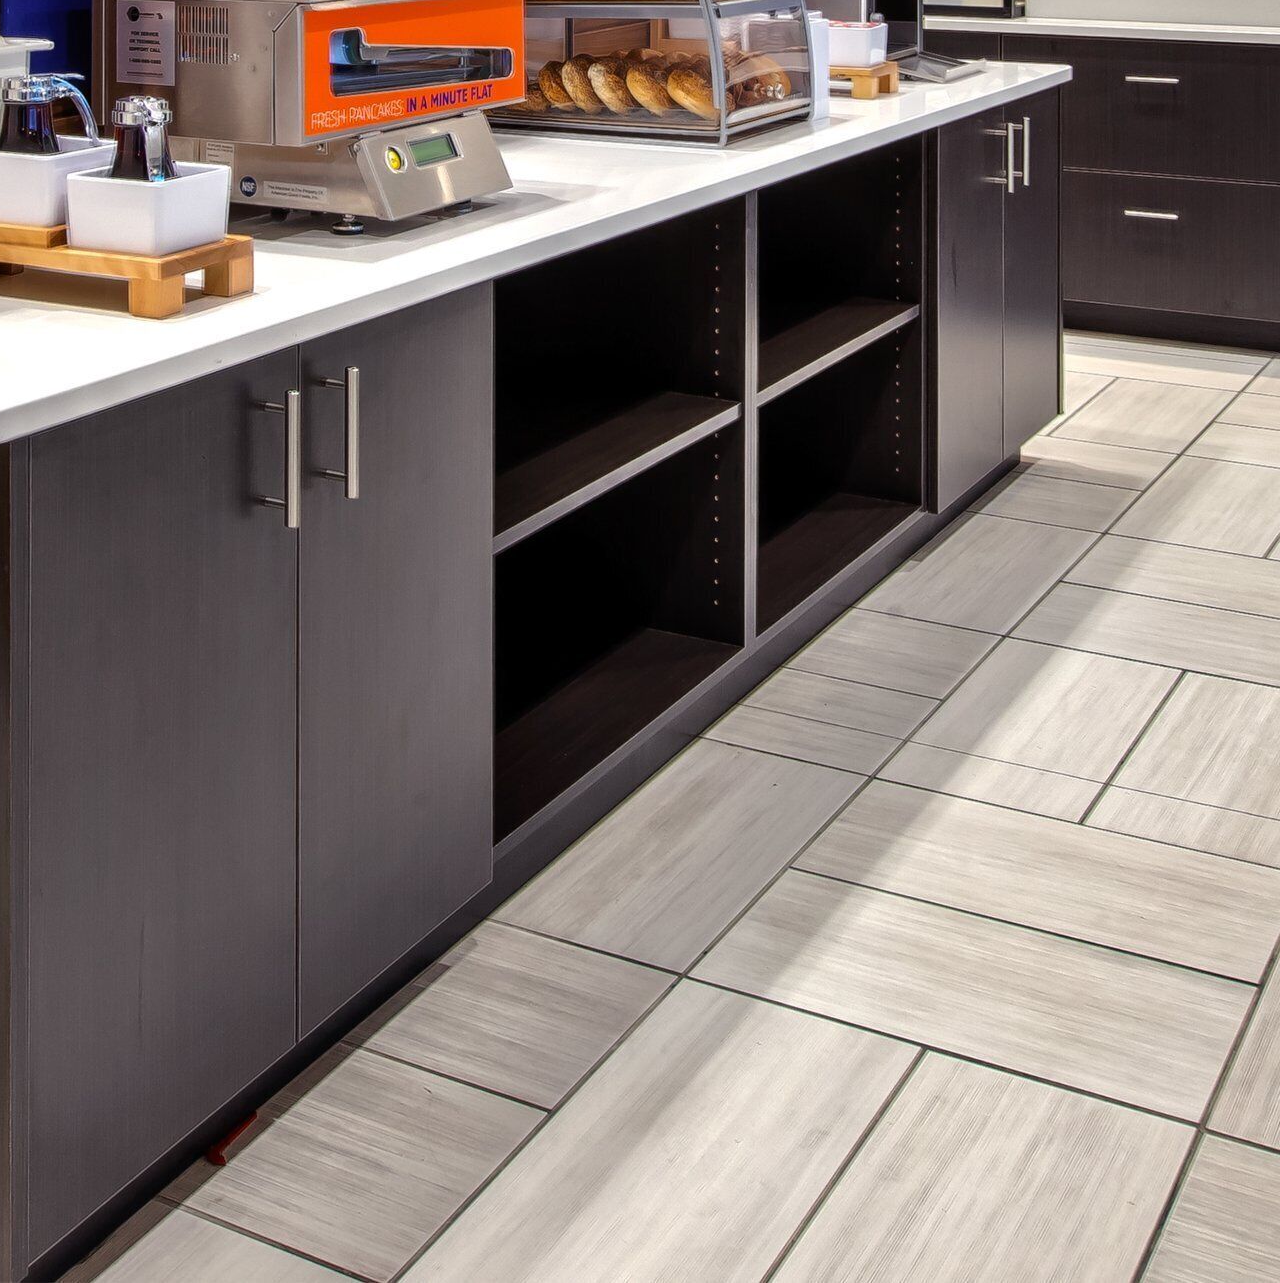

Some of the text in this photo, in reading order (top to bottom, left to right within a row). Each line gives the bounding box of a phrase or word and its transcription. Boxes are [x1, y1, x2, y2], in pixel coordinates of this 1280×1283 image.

[311, 84, 492, 130] FRESH PANCAKES IN A MINUTE FLAT
[241, 180, 256, 193] NSF
